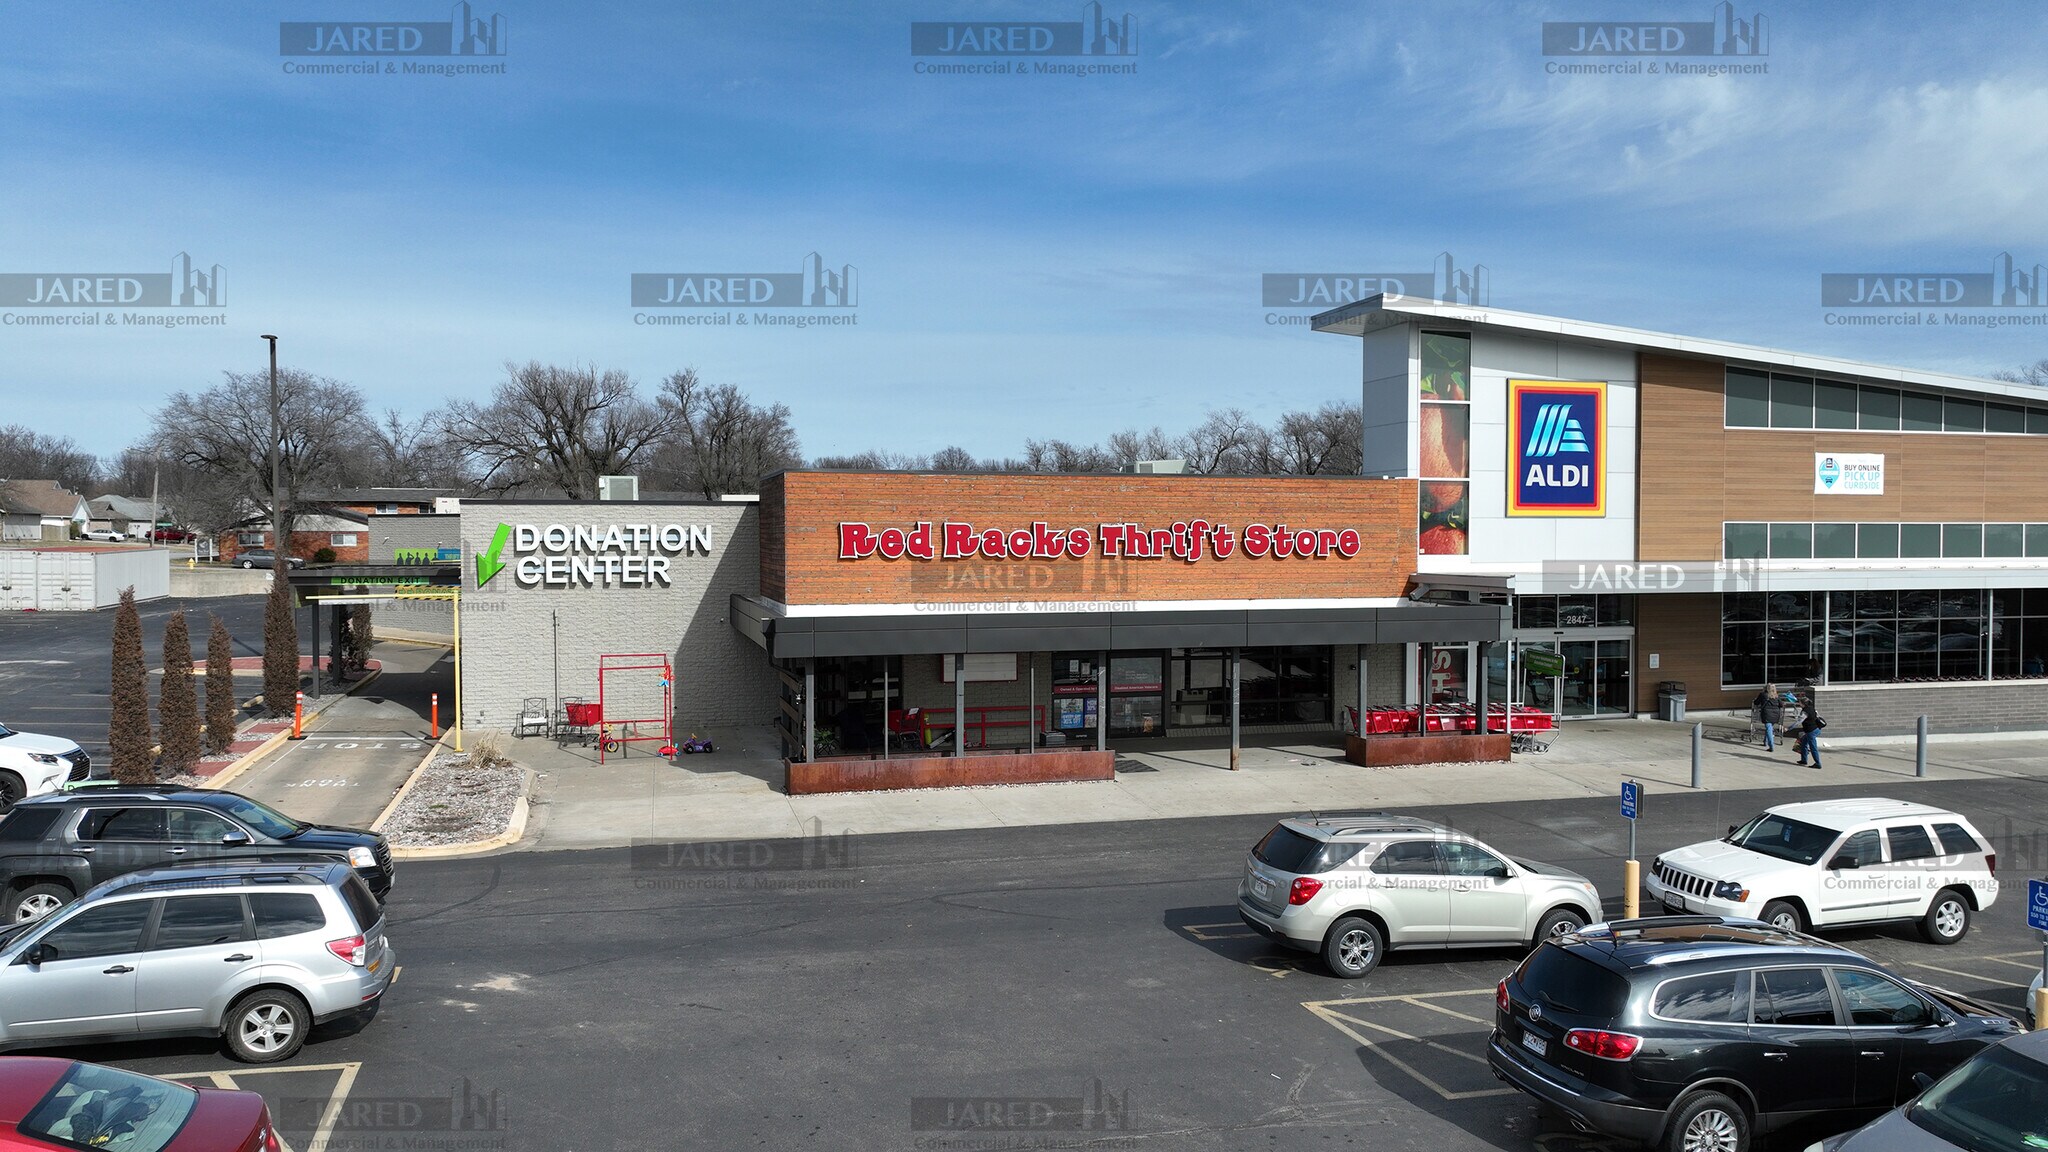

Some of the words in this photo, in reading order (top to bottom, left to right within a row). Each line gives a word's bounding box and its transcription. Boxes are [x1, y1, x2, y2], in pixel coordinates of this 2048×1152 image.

[1526, 465, 1588, 487] ALDI
[1844, 472, 1865, 481] PICK
[1868, 472, 1880, 481] UP
[515, 524, 712, 554] DONATION
[838, 521, 934, 560] Red
[943, 521, 1092, 559] Racks
[1100, 519, 1236, 562] Thrift
[1244, 524, 1361, 558] Store
[340, 576, 393, 584] DONATION
[397, 576, 420, 584] EXIT
[516, 556, 672, 585] CENTER
[1566, 616, 1587, 624] 2847
